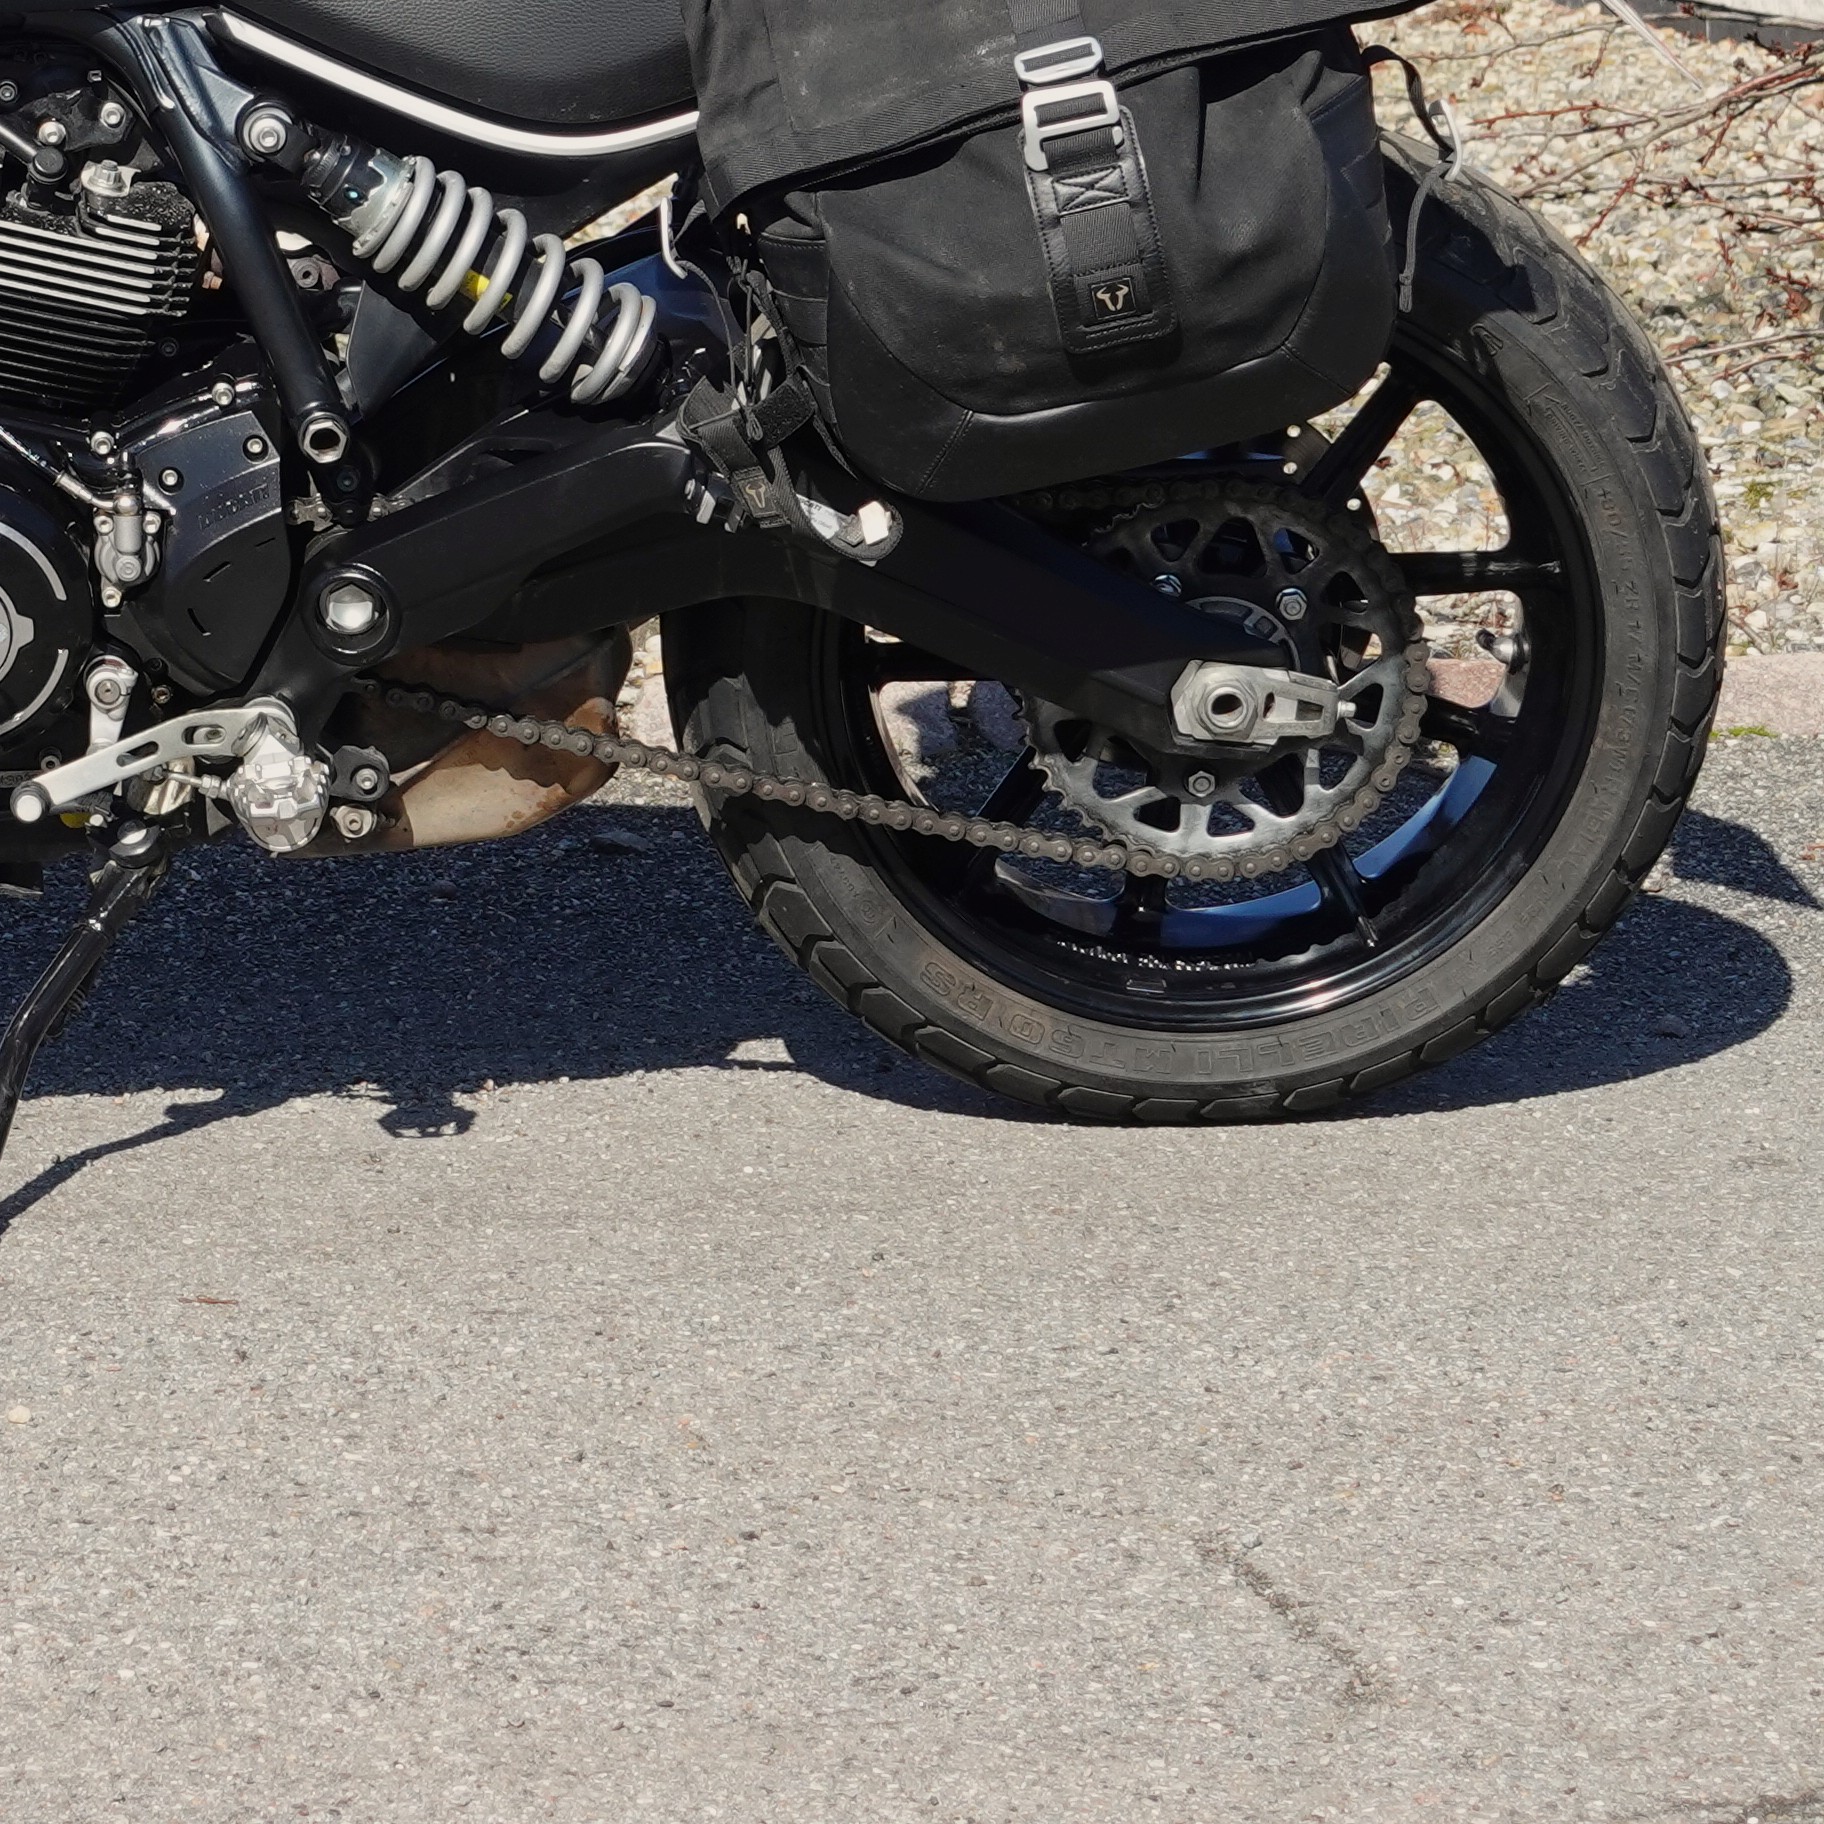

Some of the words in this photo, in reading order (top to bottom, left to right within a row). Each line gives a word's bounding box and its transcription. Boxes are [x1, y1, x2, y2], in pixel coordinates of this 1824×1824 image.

[913, 958, 998, 1023] RS
[1004, 1013, 1174, 1073] MT60
[1193, 985, 1443, 1073] PIRELLI
